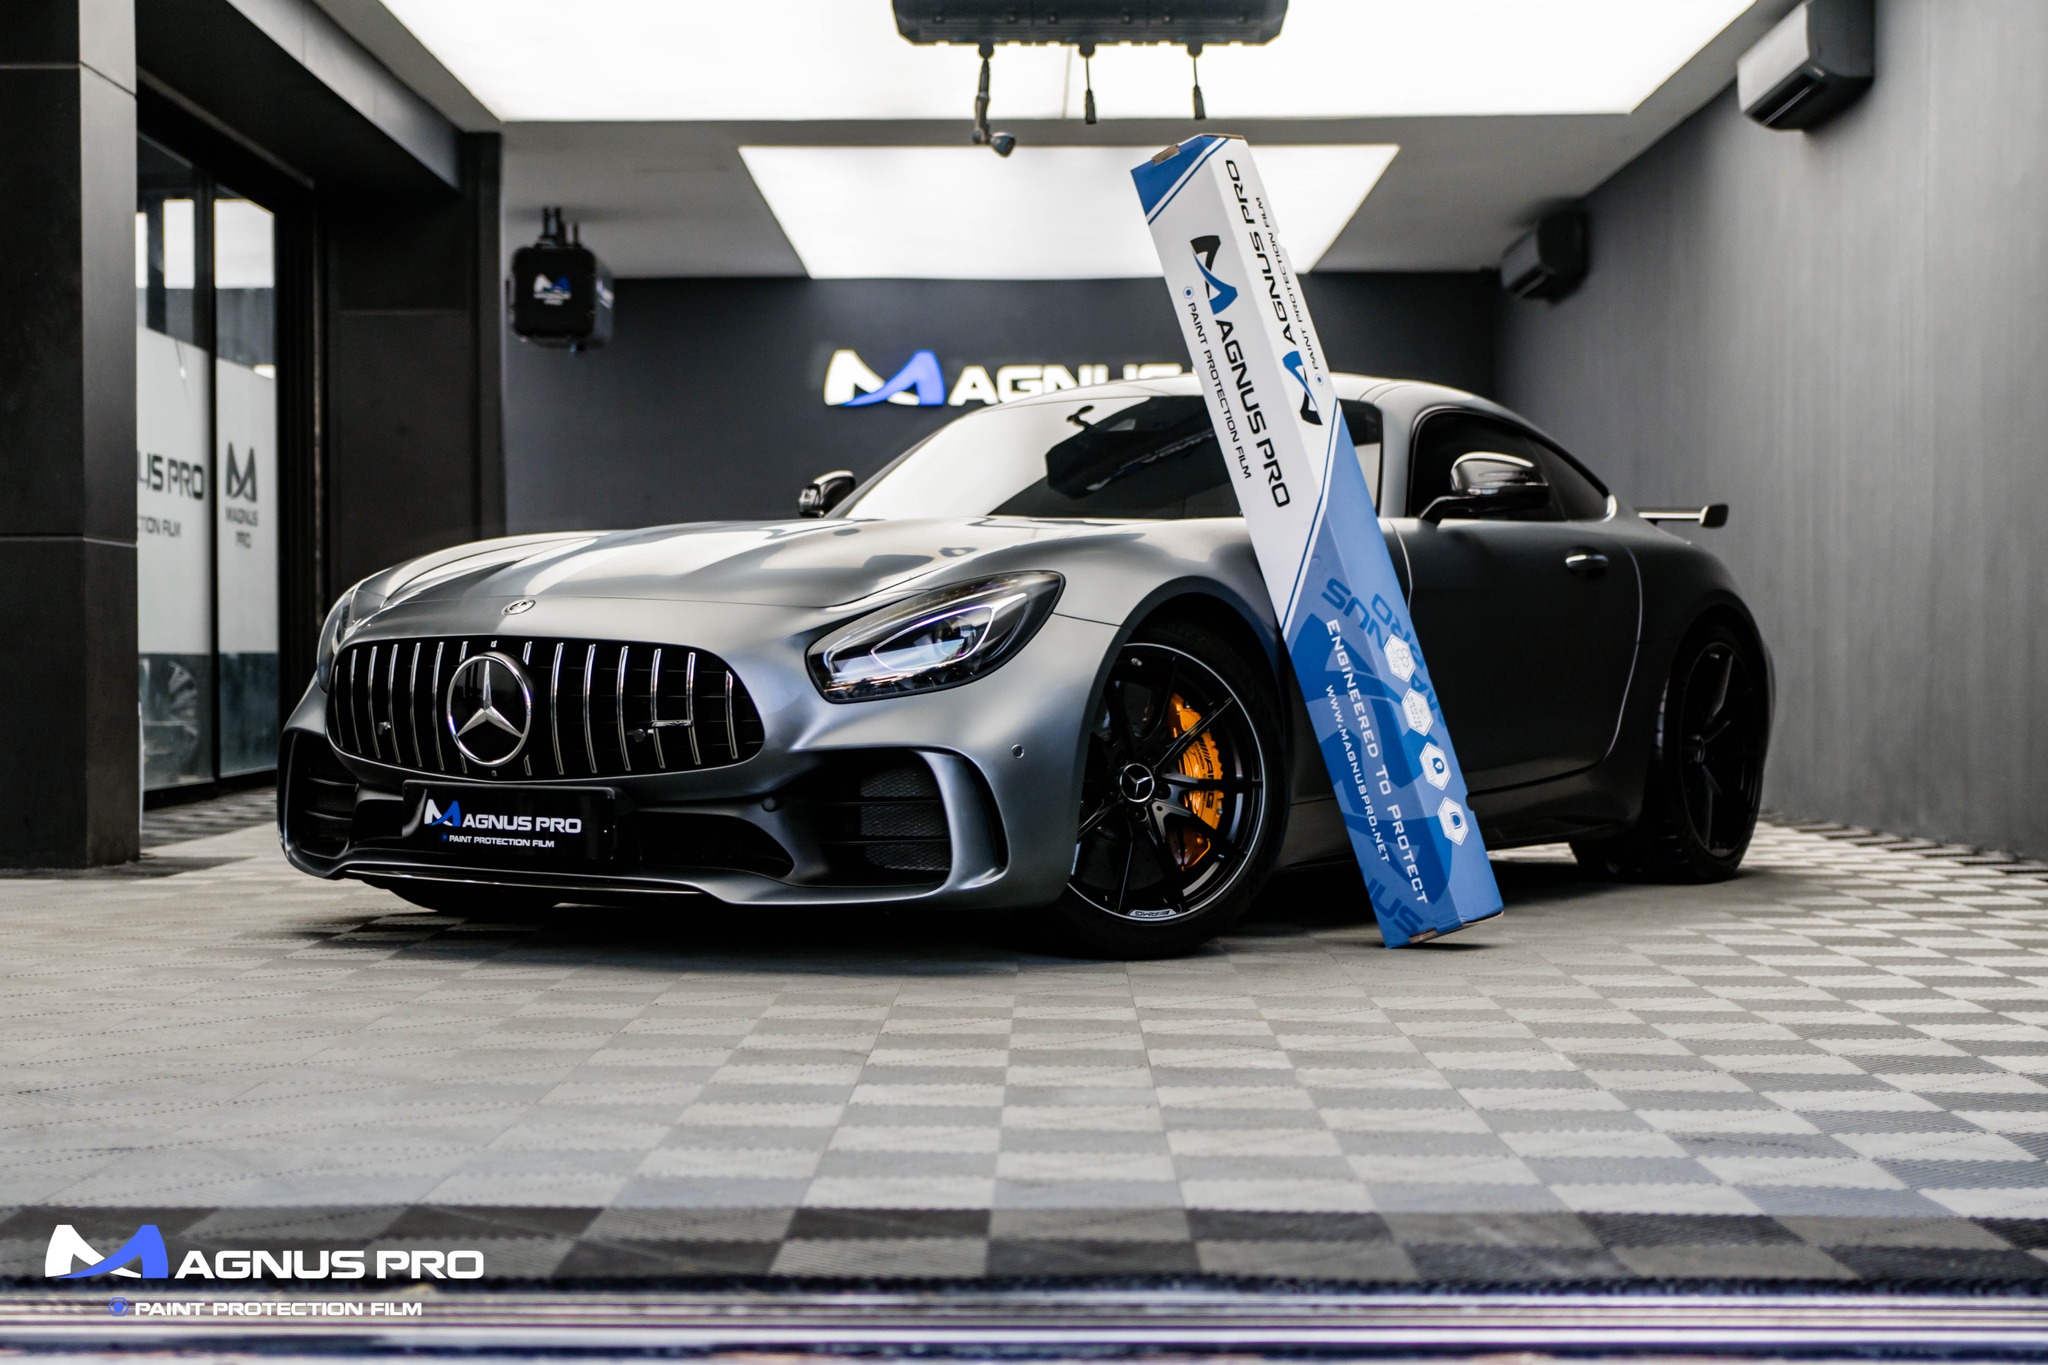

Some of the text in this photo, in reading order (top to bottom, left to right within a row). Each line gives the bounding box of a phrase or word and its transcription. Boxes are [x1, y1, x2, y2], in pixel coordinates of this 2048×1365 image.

[1226, 160, 1255, 224] PRO
[1256, 196, 1318, 370] PAINT PROTECTION FILM
[1188, 302, 1252, 479] PAINT PROTECTION FILM
[168, 458, 204, 500] PRO
[1256, 437, 1290, 508] PRO
[1326, 619, 1428, 904] ENGINEERED TO PROTECT
[1326, 684, 1390, 863] WWW.MAGNUSPRO.NET
[449, 834, 554, 848] PAINT PROTECTION FILM
[535, 817, 582, 833] PRO
